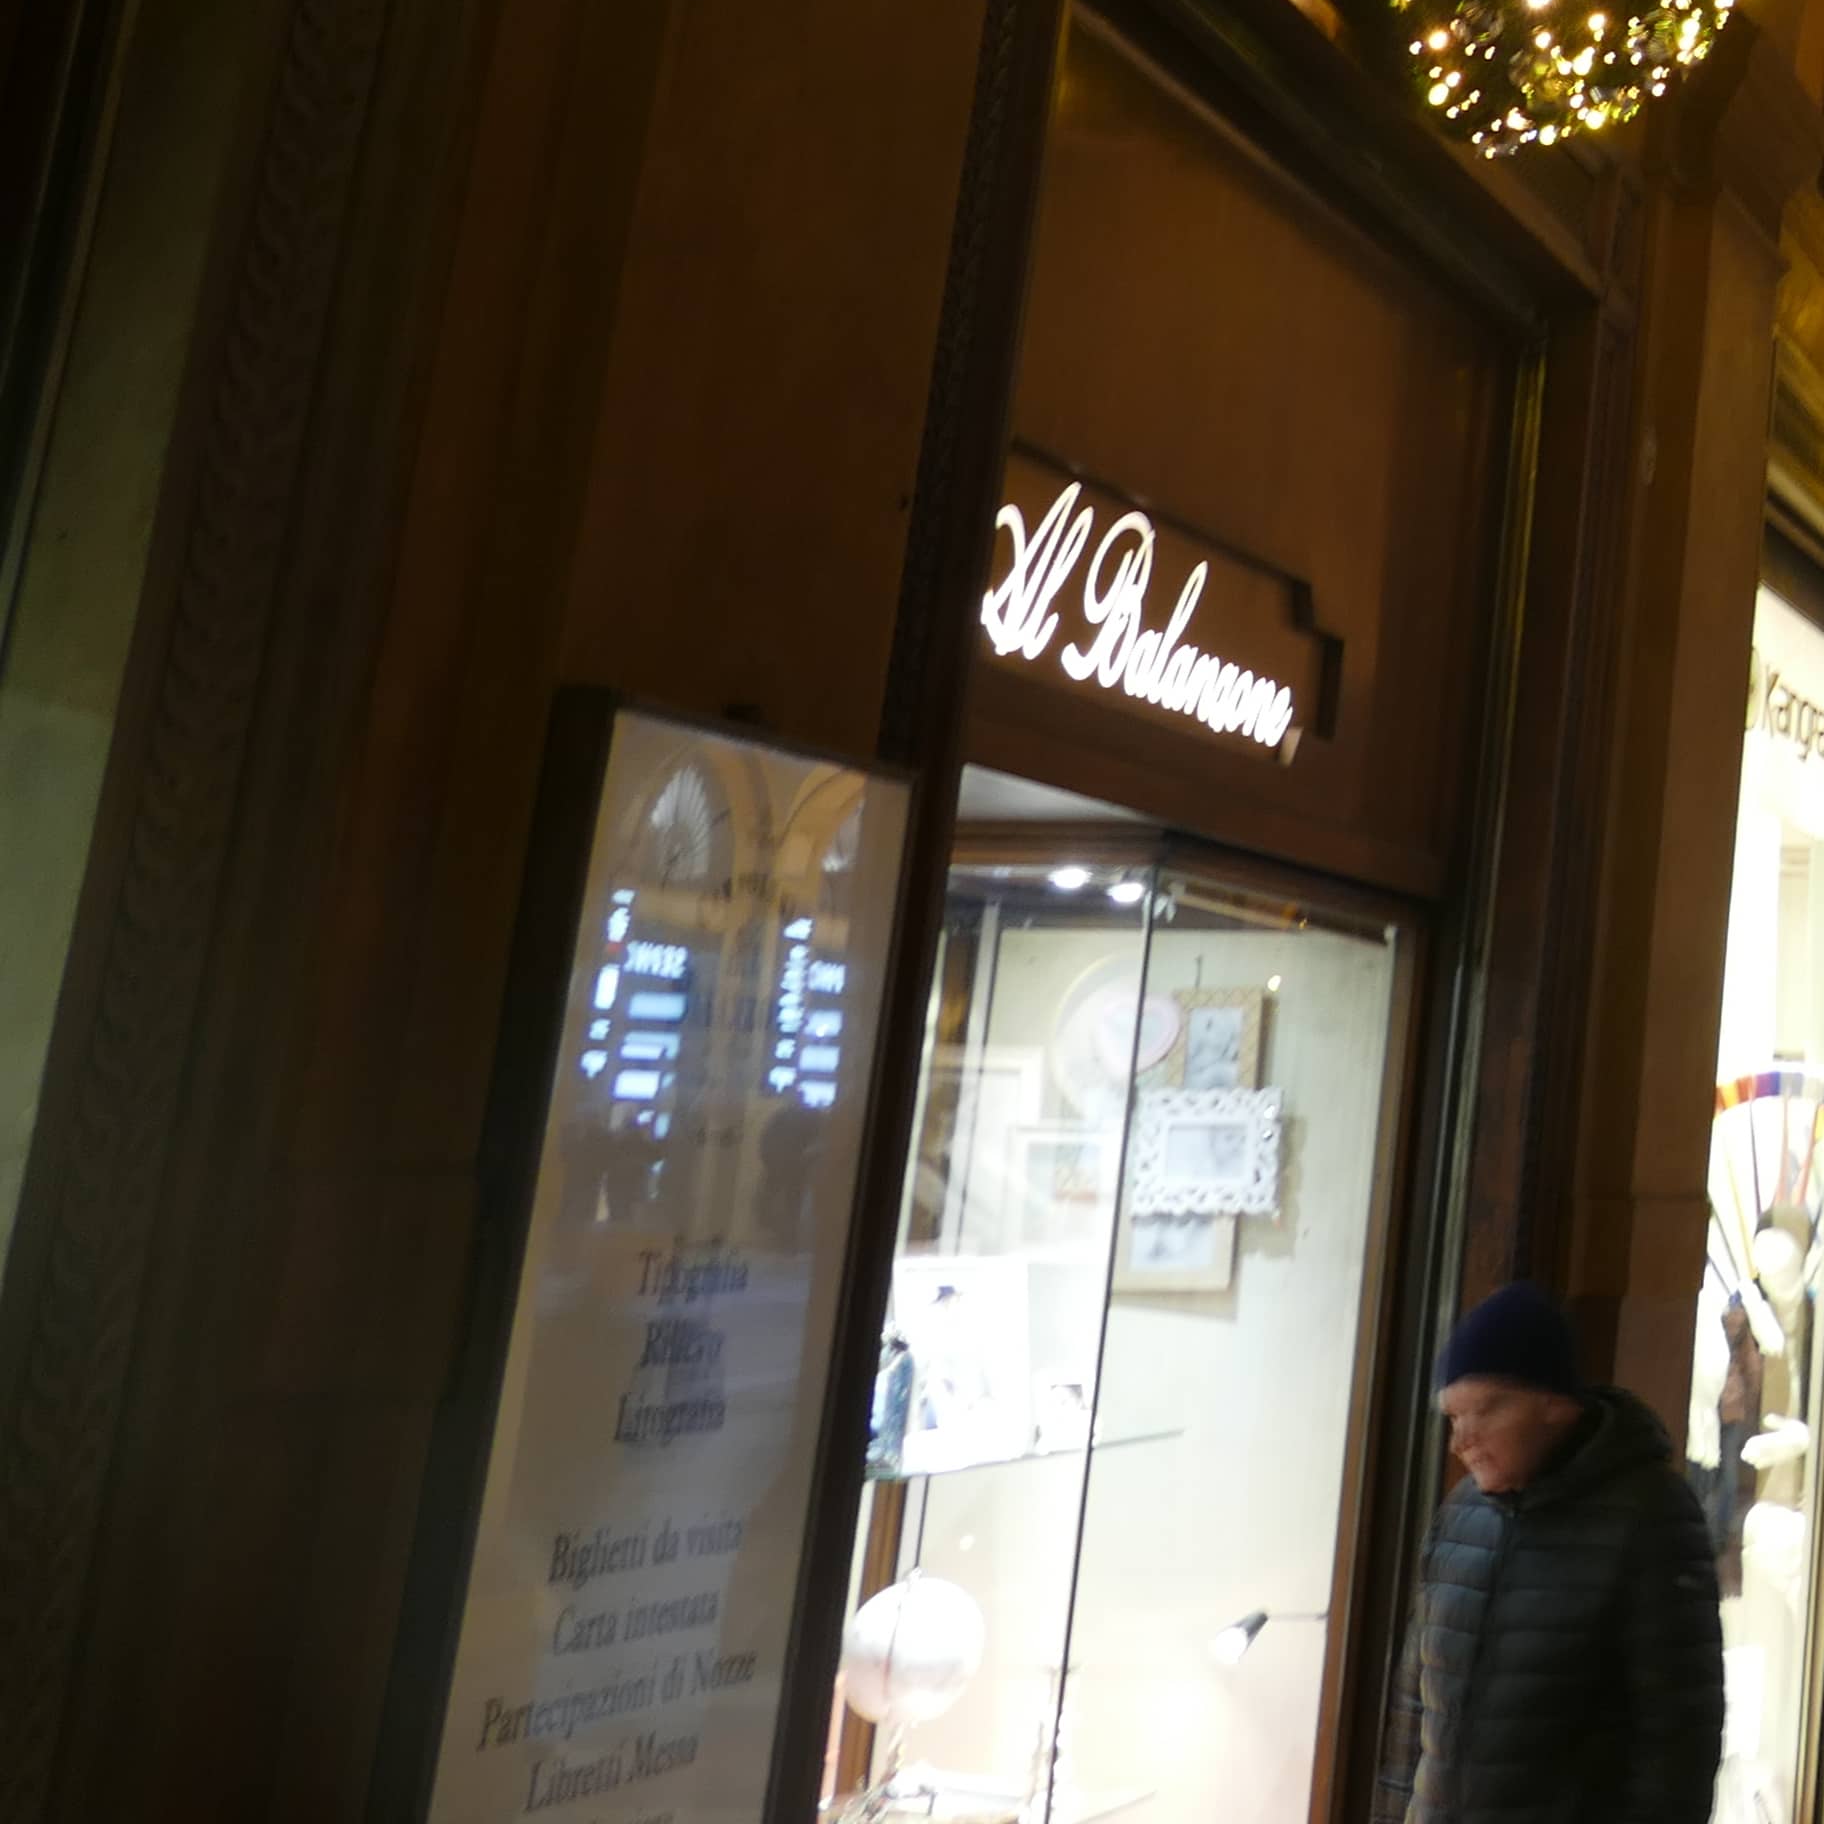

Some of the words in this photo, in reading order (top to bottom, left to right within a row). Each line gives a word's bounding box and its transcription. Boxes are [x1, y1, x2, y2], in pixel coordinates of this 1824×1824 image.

[548, 1523, 649, 1591] Biglietti
[652, 1518, 681, 1566] da
[553, 1603, 617, 1657] Carta
[624, 1587, 720, 1643] intestata
[476, 1674, 656, 1753] Partecipazioni
[660, 1653, 683, 1706] di
[690, 1650, 757, 1697] Nozze
[525, 1739, 622, 1814] Libretti
